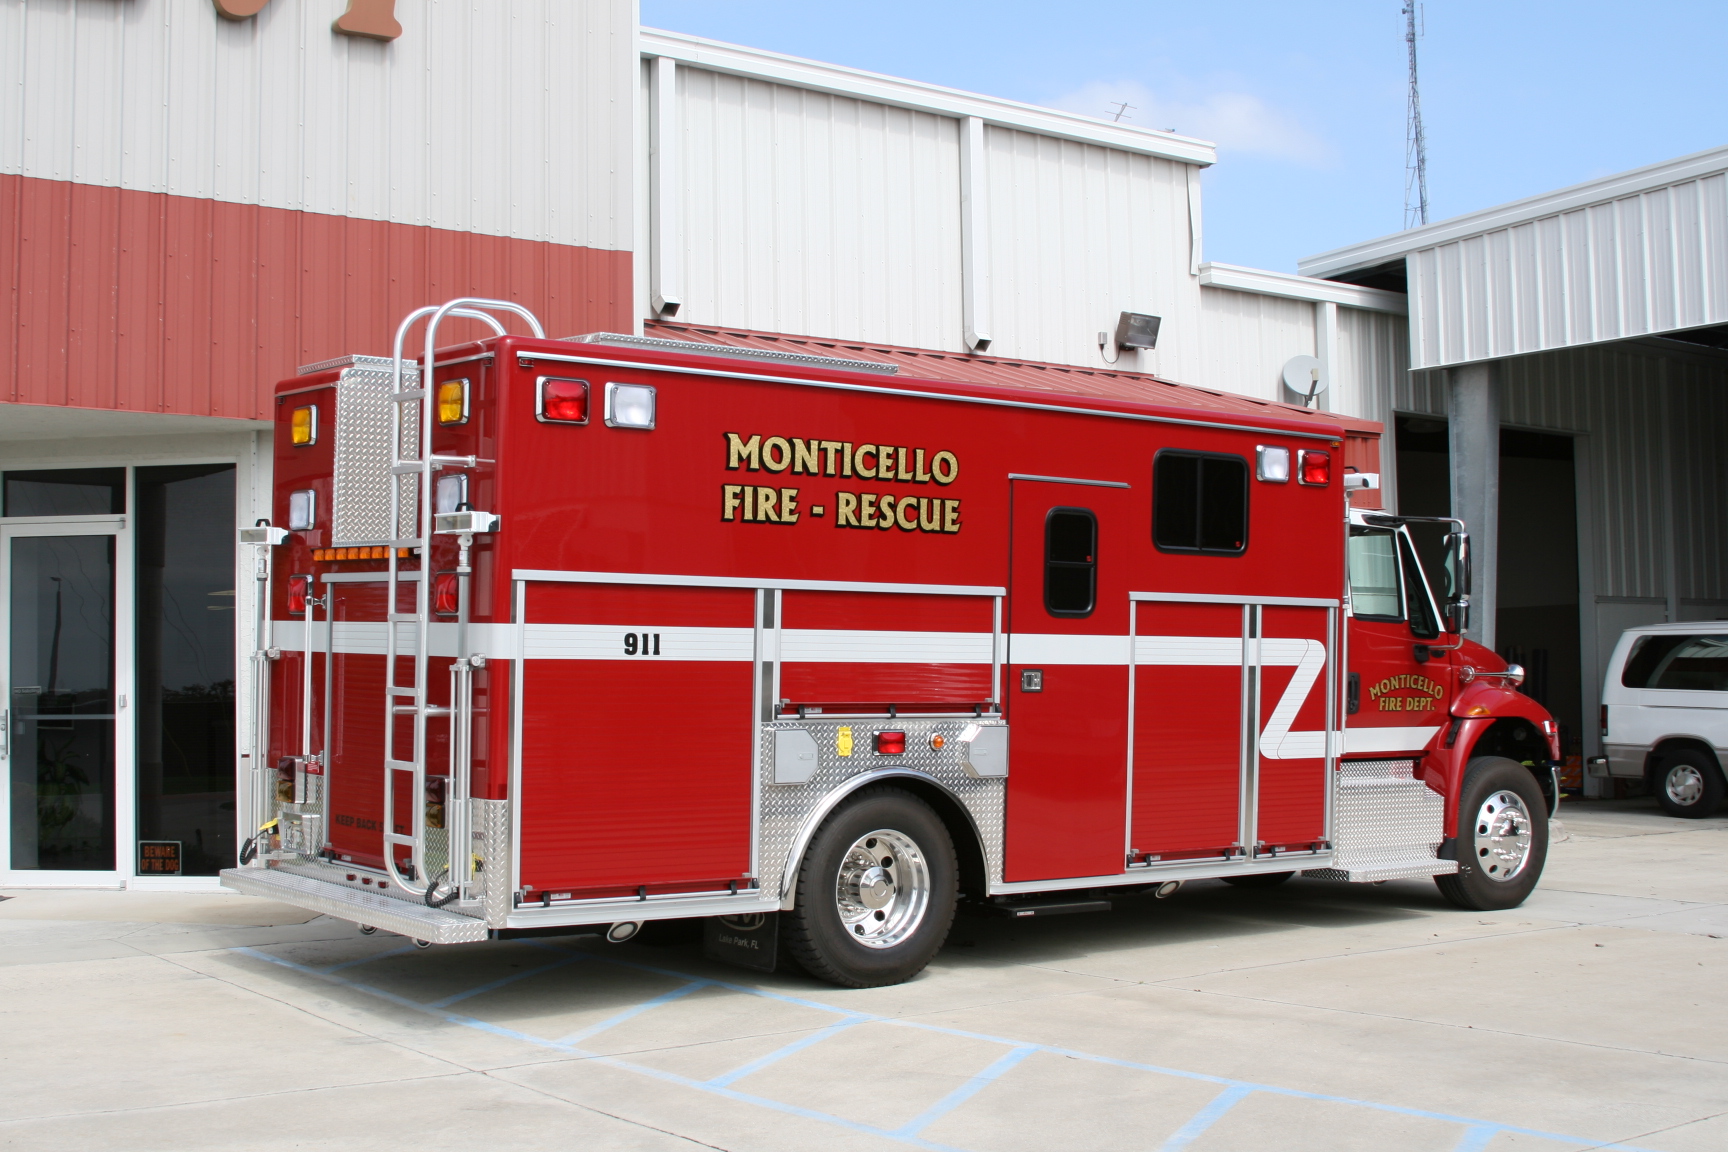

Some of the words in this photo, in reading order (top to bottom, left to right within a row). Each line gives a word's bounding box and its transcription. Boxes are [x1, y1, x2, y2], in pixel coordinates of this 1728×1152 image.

[722, 431, 960, 487] MONTICELLO
[720, 484, 801, 525] FIRE
[834, 491, 962, 535] RESCUE
[624, 632, 661, 656] 911
[1368, 674, 1444, 701] MONTICELLO
[1379, 697, 1403, 711] FIRE
[1405, 697, 1435, 711] DEPT.
[335, 814, 355, 826] KEEP
[356, 818, 377, 831] BACK
[144, 845, 176, 858] BEWARE
[141, 858, 150, 871] OF
[151, 858, 164, 871] THE
[165, 858, 179, 871] DOG
[718, 934, 733, 944] Lake
[733, 936, 750, 949] Park,
[750, 939, 759, 950] FL
